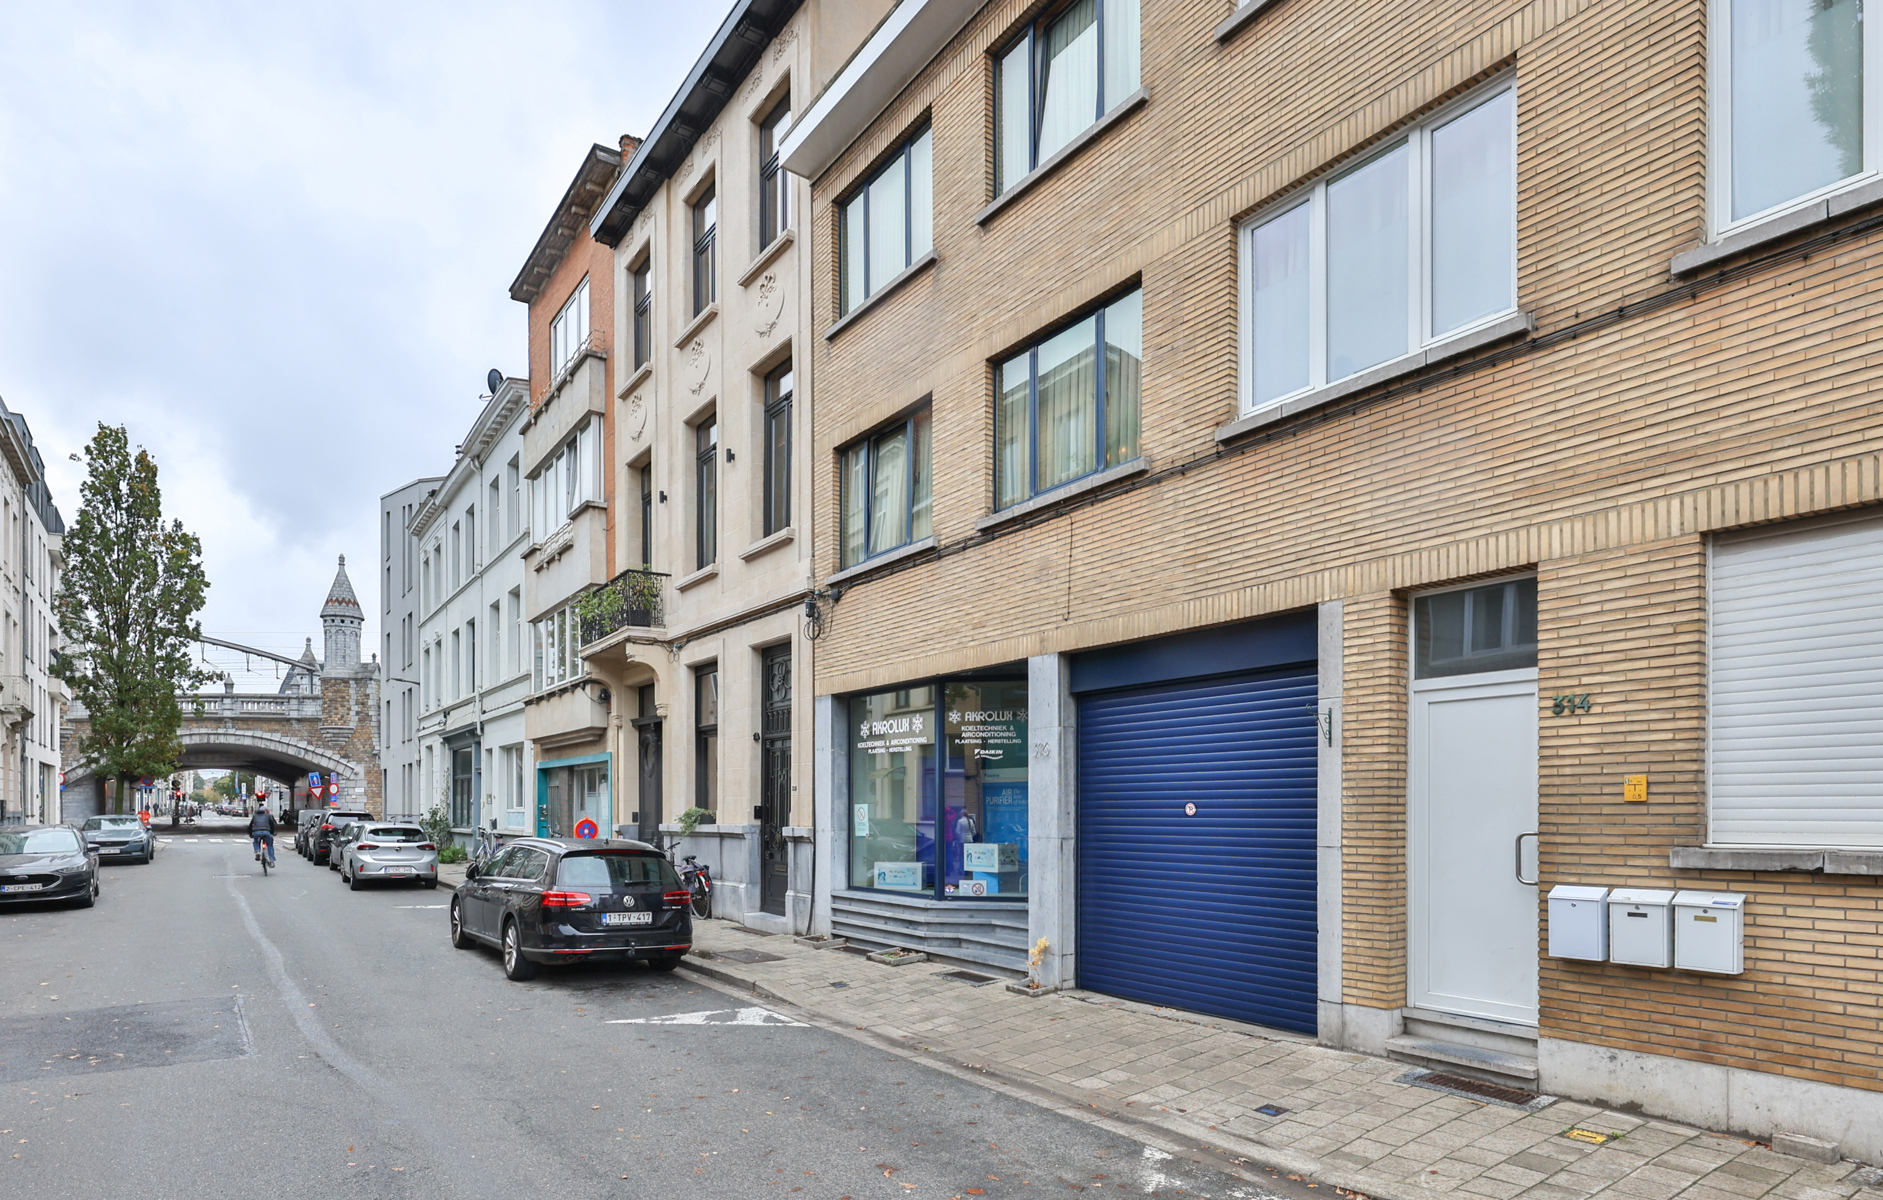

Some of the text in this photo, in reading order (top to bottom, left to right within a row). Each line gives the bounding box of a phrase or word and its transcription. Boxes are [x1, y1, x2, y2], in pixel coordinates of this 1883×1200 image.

[1551, 693, 1592, 715] 314
[965, 711, 1013, 722] AKROLUX
[872, 718, 910, 736] AKROLUX
[857, 740, 885, 749] KOELTECHNIEK
[891, 737, 928, 746] AIRCONDITIONING
[1002, 788, 1012, 796] AIR
[985, 796, 1013, 804] PURIFIER
[5, 884, 42, 892] 2-CPE-412
[608, 913, 651, 922] 1-TPV-417
